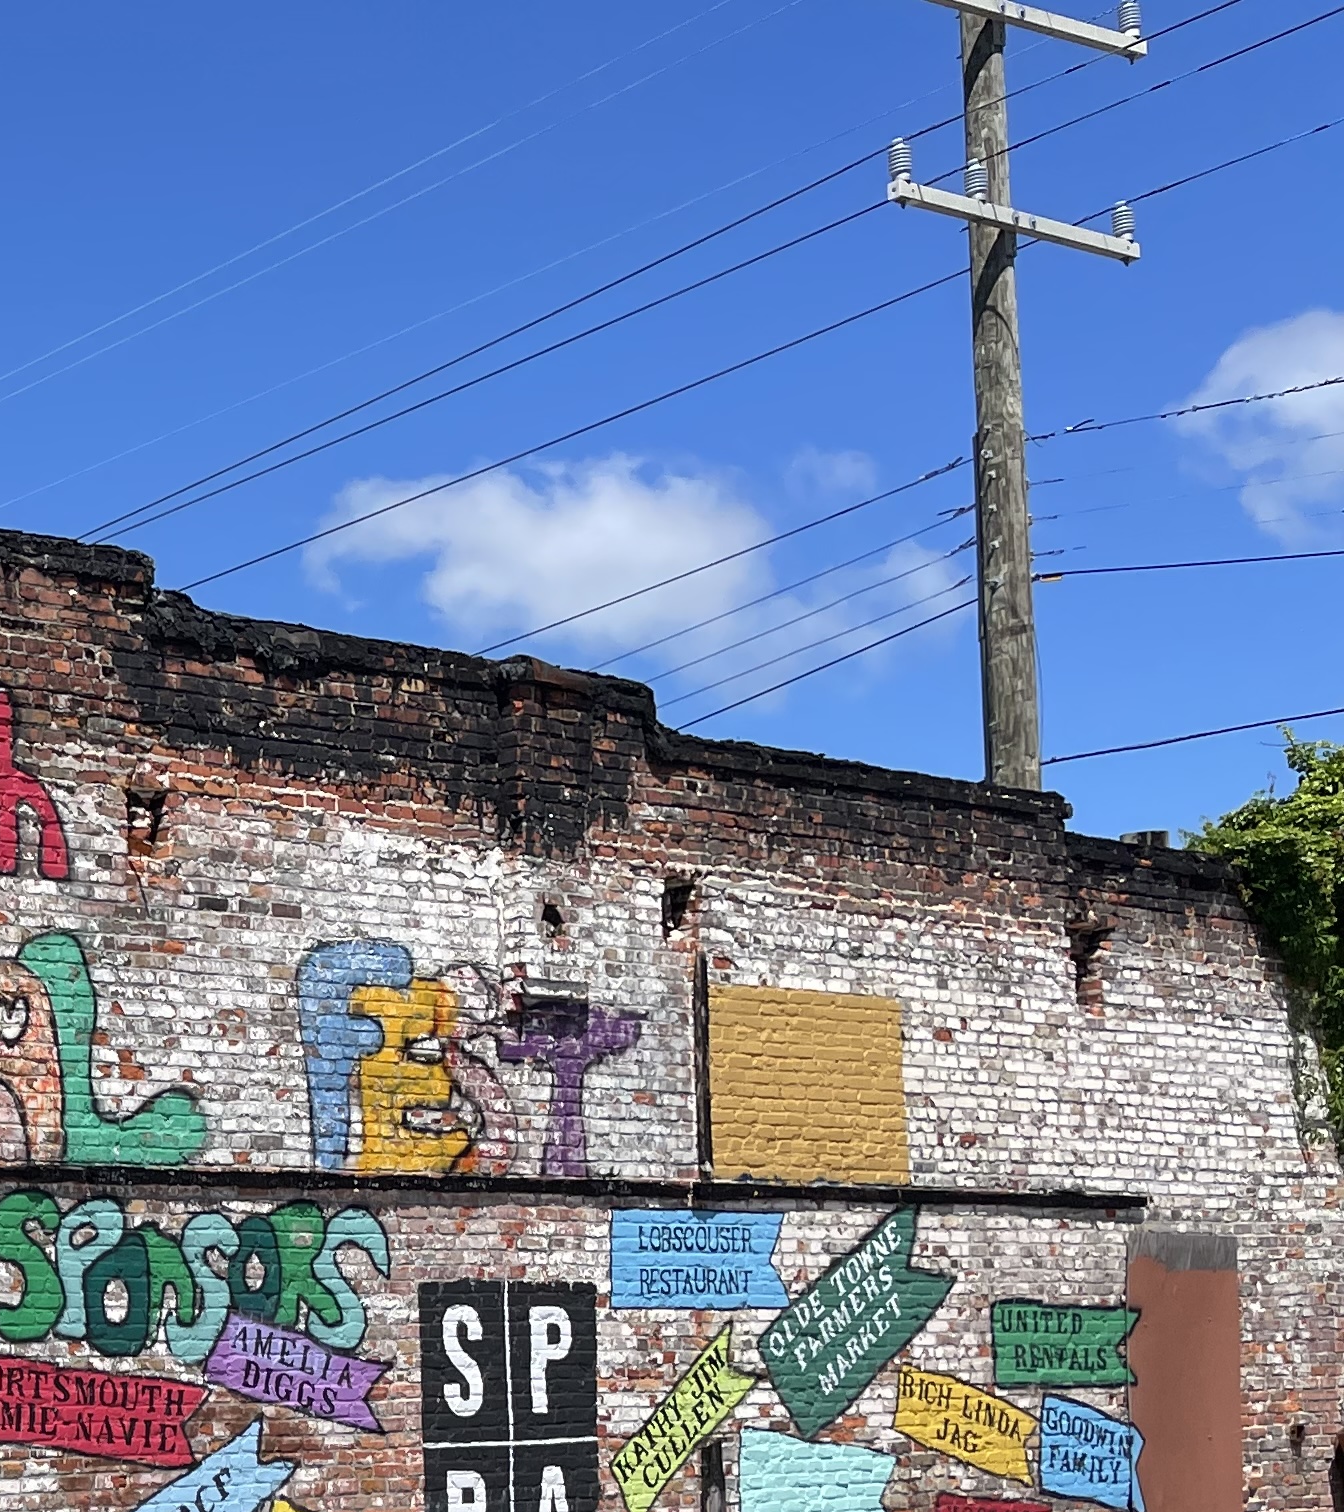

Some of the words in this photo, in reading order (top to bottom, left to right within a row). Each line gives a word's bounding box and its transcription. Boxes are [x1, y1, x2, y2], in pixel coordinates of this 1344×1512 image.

[295, 936, 649, 1177] FEST
[638, 1268, 754, 1296] RESTAURANT
[768, 1289, 824, 1358] OLDE
[830, 1221, 904, 1297] TOWNE
[793, 1264, 896, 1372] FARMERS
[230, 1326, 355, 1390] AMELIA
[818, 1293, 905, 1396] MARKET
[999, 1309, 1082, 1335] UNITED
[1014, 1343, 1108, 1372] RENTALS
[242, 1360, 339, 1416] DIGGS
[441, 1305, 485, 1418] S
[528, 1306, 573, 1414] P
[612, 1395, 682, 1484] KATHY
[690, 1345, 727, 1400] JIM
[641, 1388, 731, 1489] CULLEN
[901, 1368, 953, 1410] RICH
[961, 1393, 1022, 1443] LINDA
[936, 1416, 982, 1454] JAG
[1043, 1405, 1134, 1459] GOODWIN
